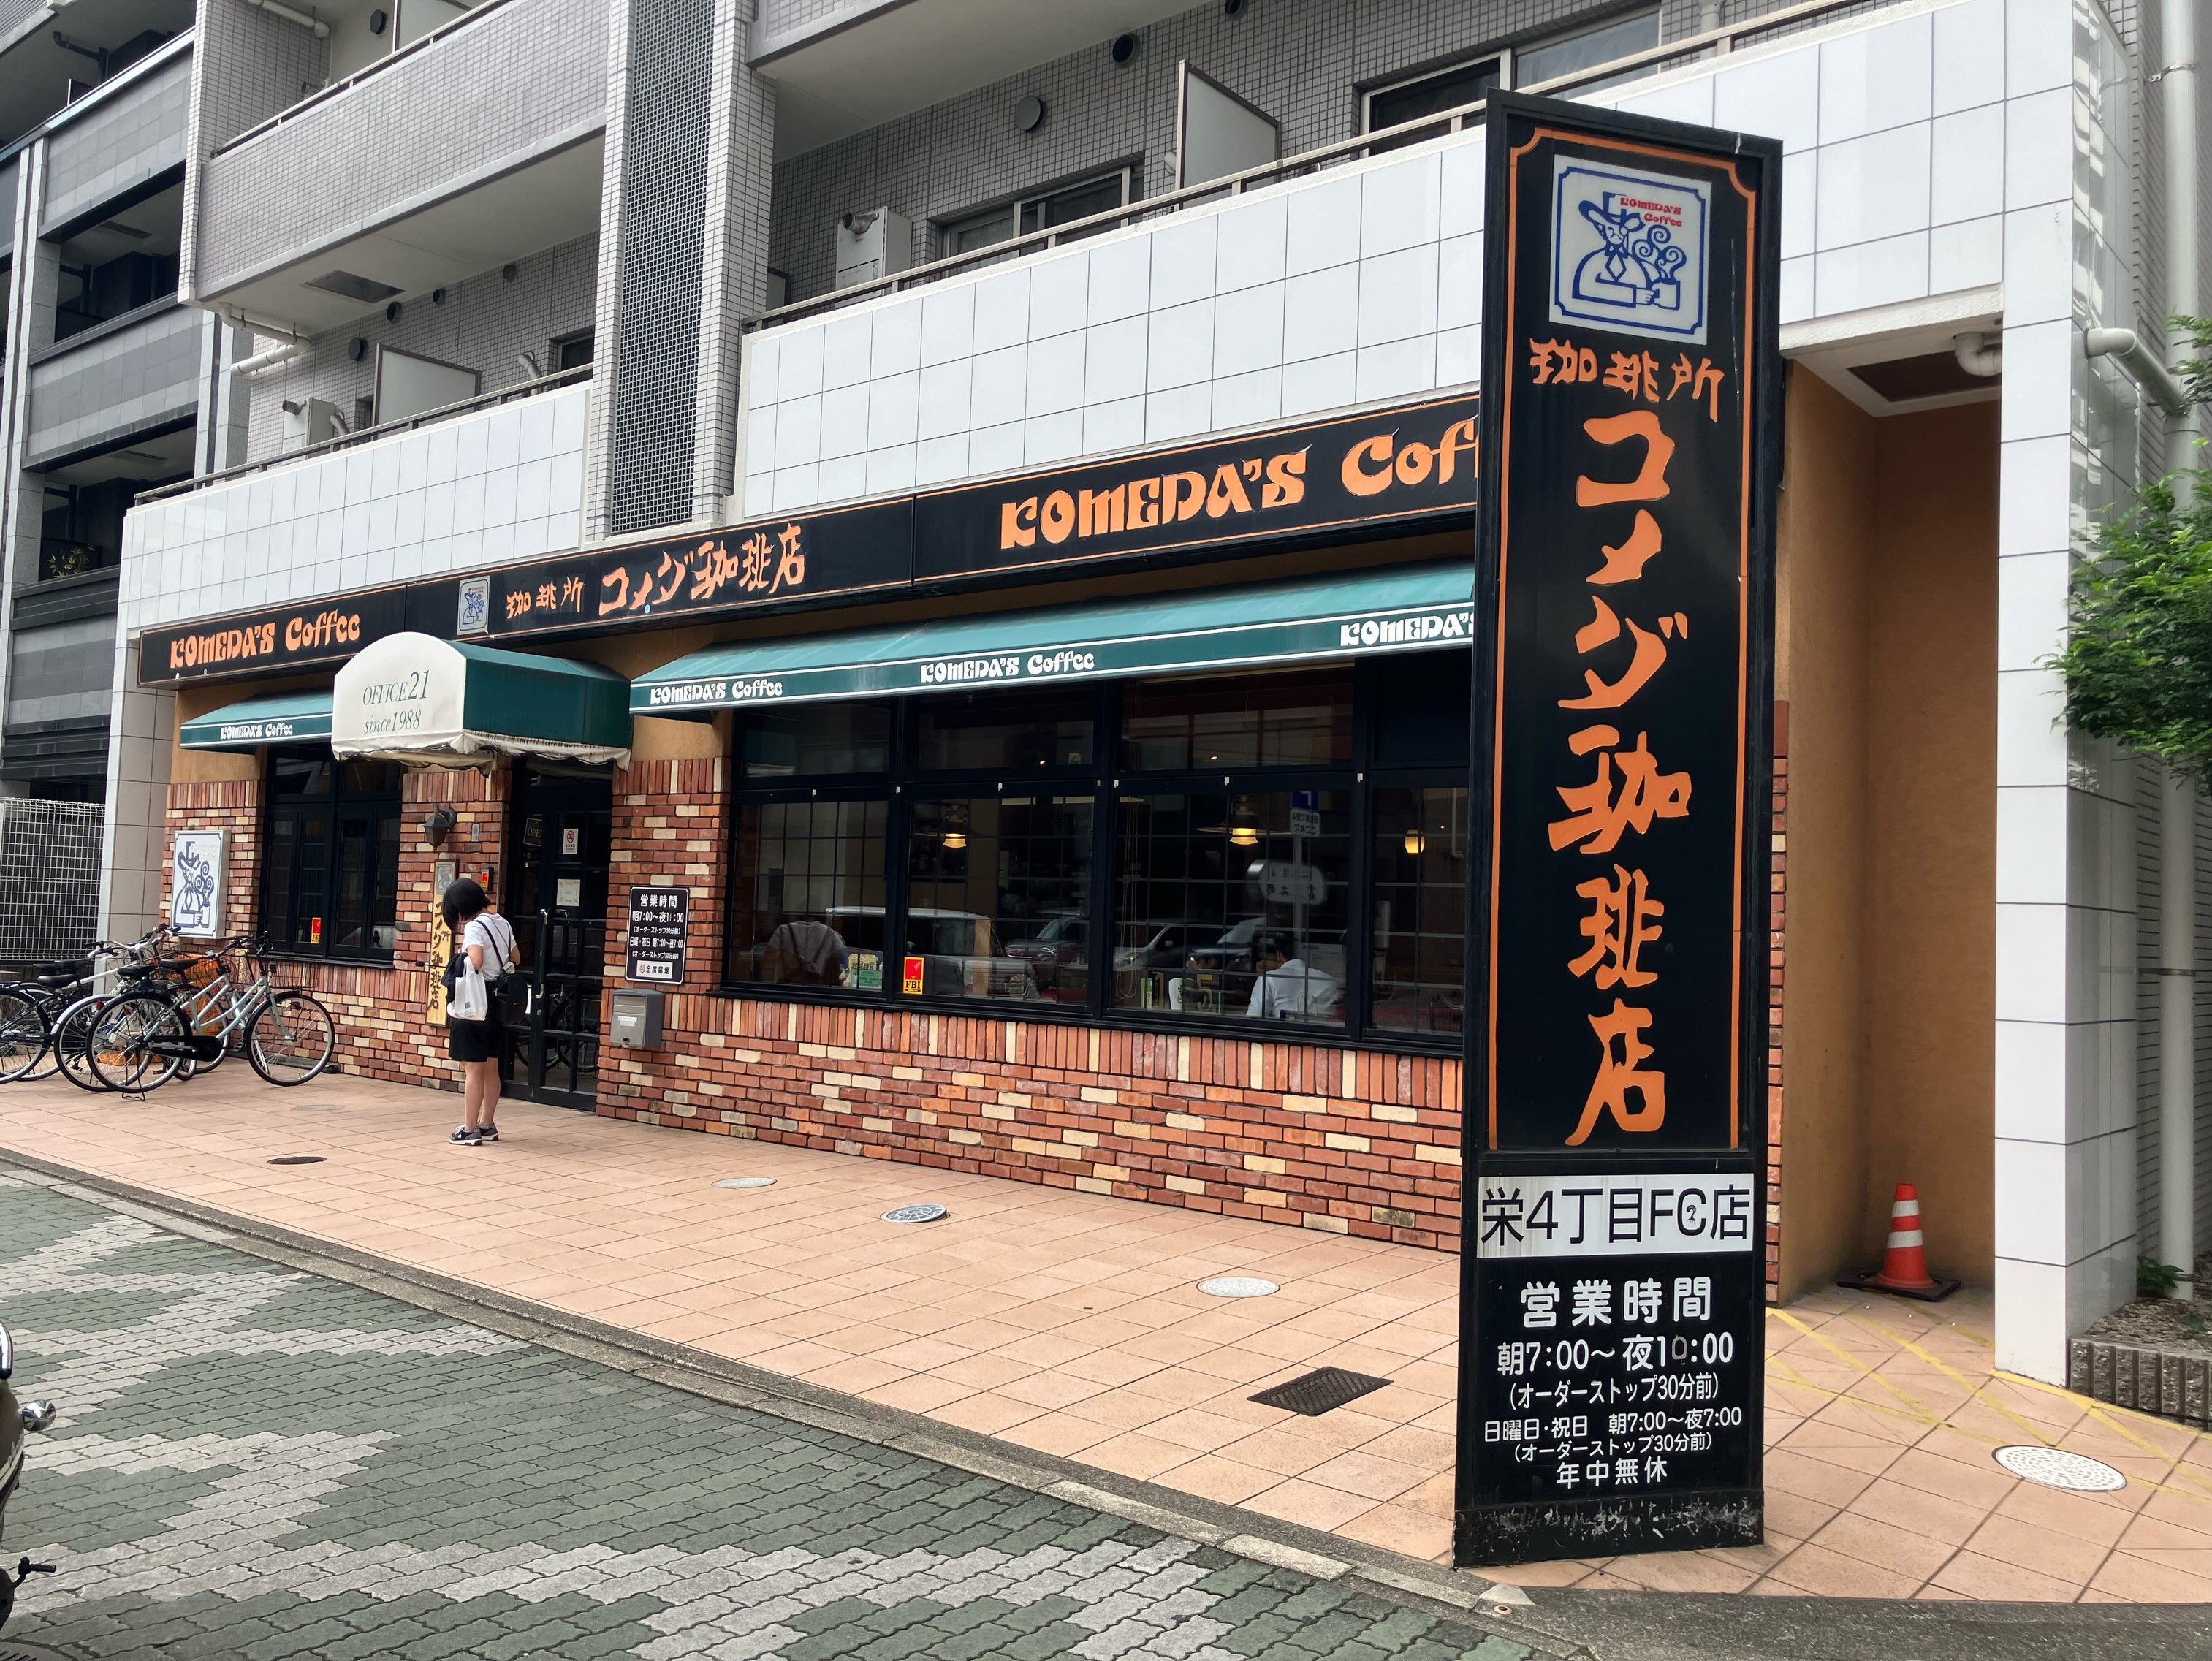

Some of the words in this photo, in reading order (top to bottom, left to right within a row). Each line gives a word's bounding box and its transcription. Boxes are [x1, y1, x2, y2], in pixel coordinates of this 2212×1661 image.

[1001, 451, 1307, 550] KOMEDA'S
[1341, 414, 1479, 497] Cof
[170, 622, 275, 669] KOMEDA'S
[286, 609, 360, 651] Coffee
[1340, 612, 1474, 647] KOMEDA'
[920, 658, 1019, 683] KOMEDA'S
[1027, 651, 1095, 674] Coffee
[363, 669, 430, 705] OFFICE21
[650, 681, 726, 704] KOMEDA'S
[732, 680, 783, 699] Coffee
[221, 723, 263, 740] KOMEDA'S
[265, 722, 293, 737] Coffee
[640, 894, 677, 908] 営業時間
[905, 980, 921, 989] FBI
[1481, 1183, 1750, 1247] 栄4丁目FC店
[1521, 1277, 1711, 1329] 営業時間
[1556, 1456, 1667, 1489] 年中無休
